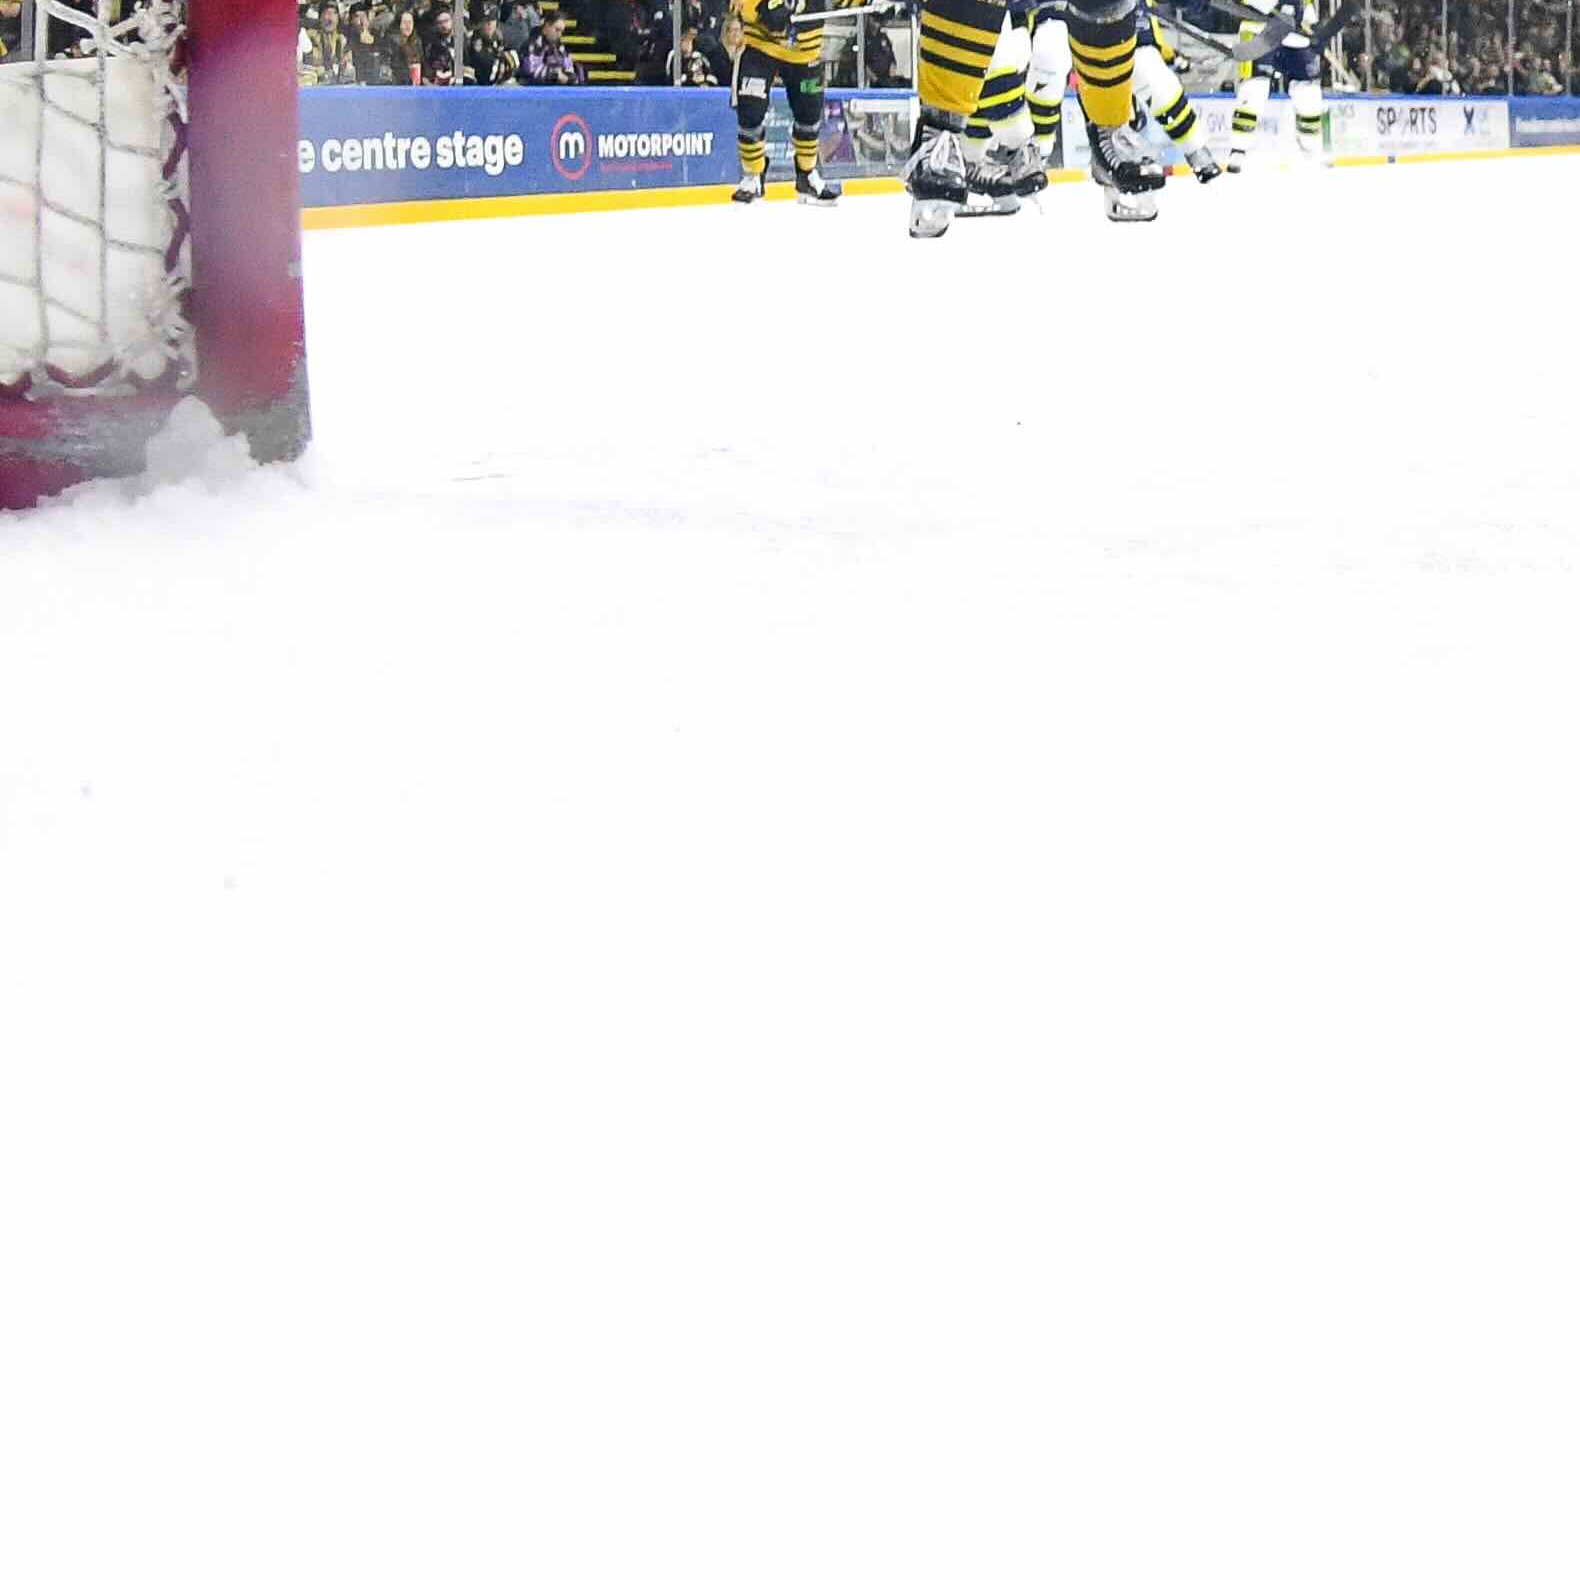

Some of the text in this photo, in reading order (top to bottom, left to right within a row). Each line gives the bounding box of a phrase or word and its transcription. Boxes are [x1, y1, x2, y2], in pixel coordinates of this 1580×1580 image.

[1376, 106, 1438, 136] SPRTS
[321, 131, 432, 173] centre
[436, 129, 525, 175] stage
[598, 131, 715, 159] MOTORPOINT
